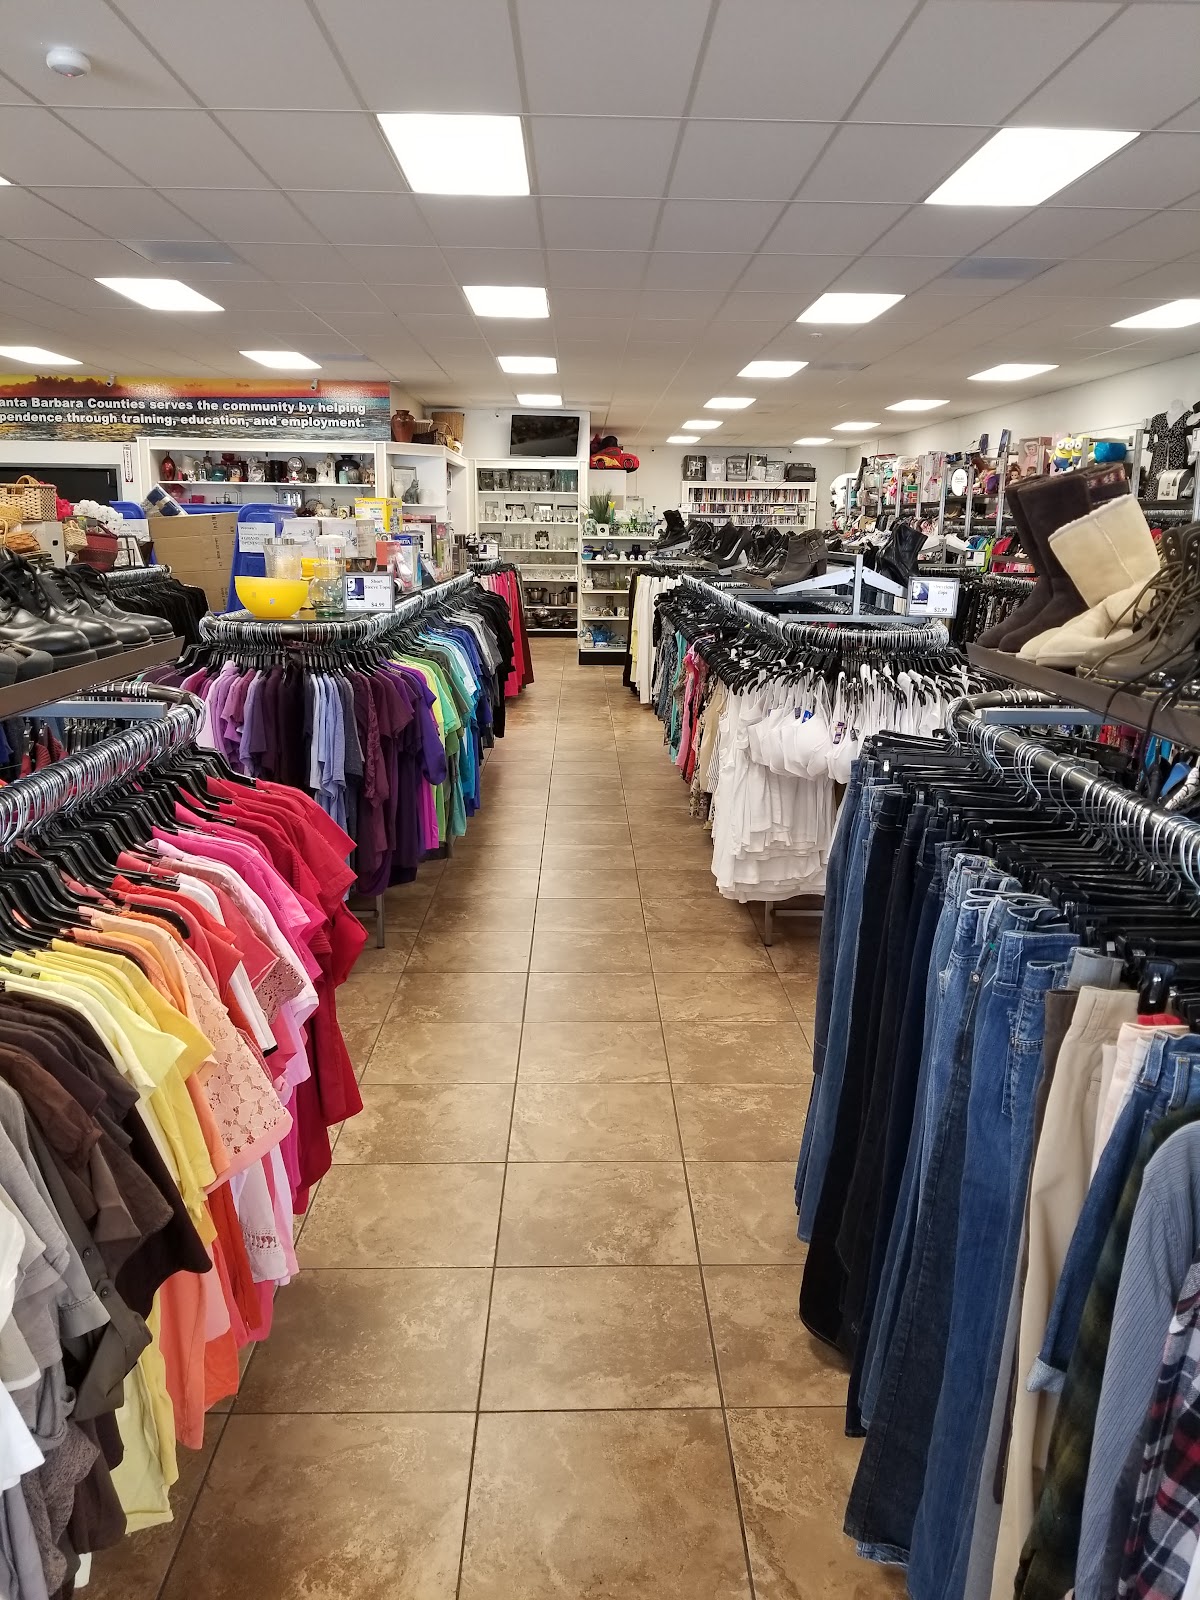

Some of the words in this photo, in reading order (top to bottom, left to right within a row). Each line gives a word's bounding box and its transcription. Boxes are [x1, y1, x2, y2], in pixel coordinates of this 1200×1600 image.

[31, 398, 83, 408] Barbara
[87, 398, 145, 409] Counties
[149, 400, 193, 410] serves
[197, 400, 218, 411] the
[222, 402, 295, 414] community
[299, 402, 314, 415] by
[318, 403, 366, 415] helping
[66, 413, 117, 425] through
[120, 414, 176, 426] training,
[180, 415, 250, 428] education,
[253, 416, 277, 426] and
[281, 417, 365, 429] employment.
